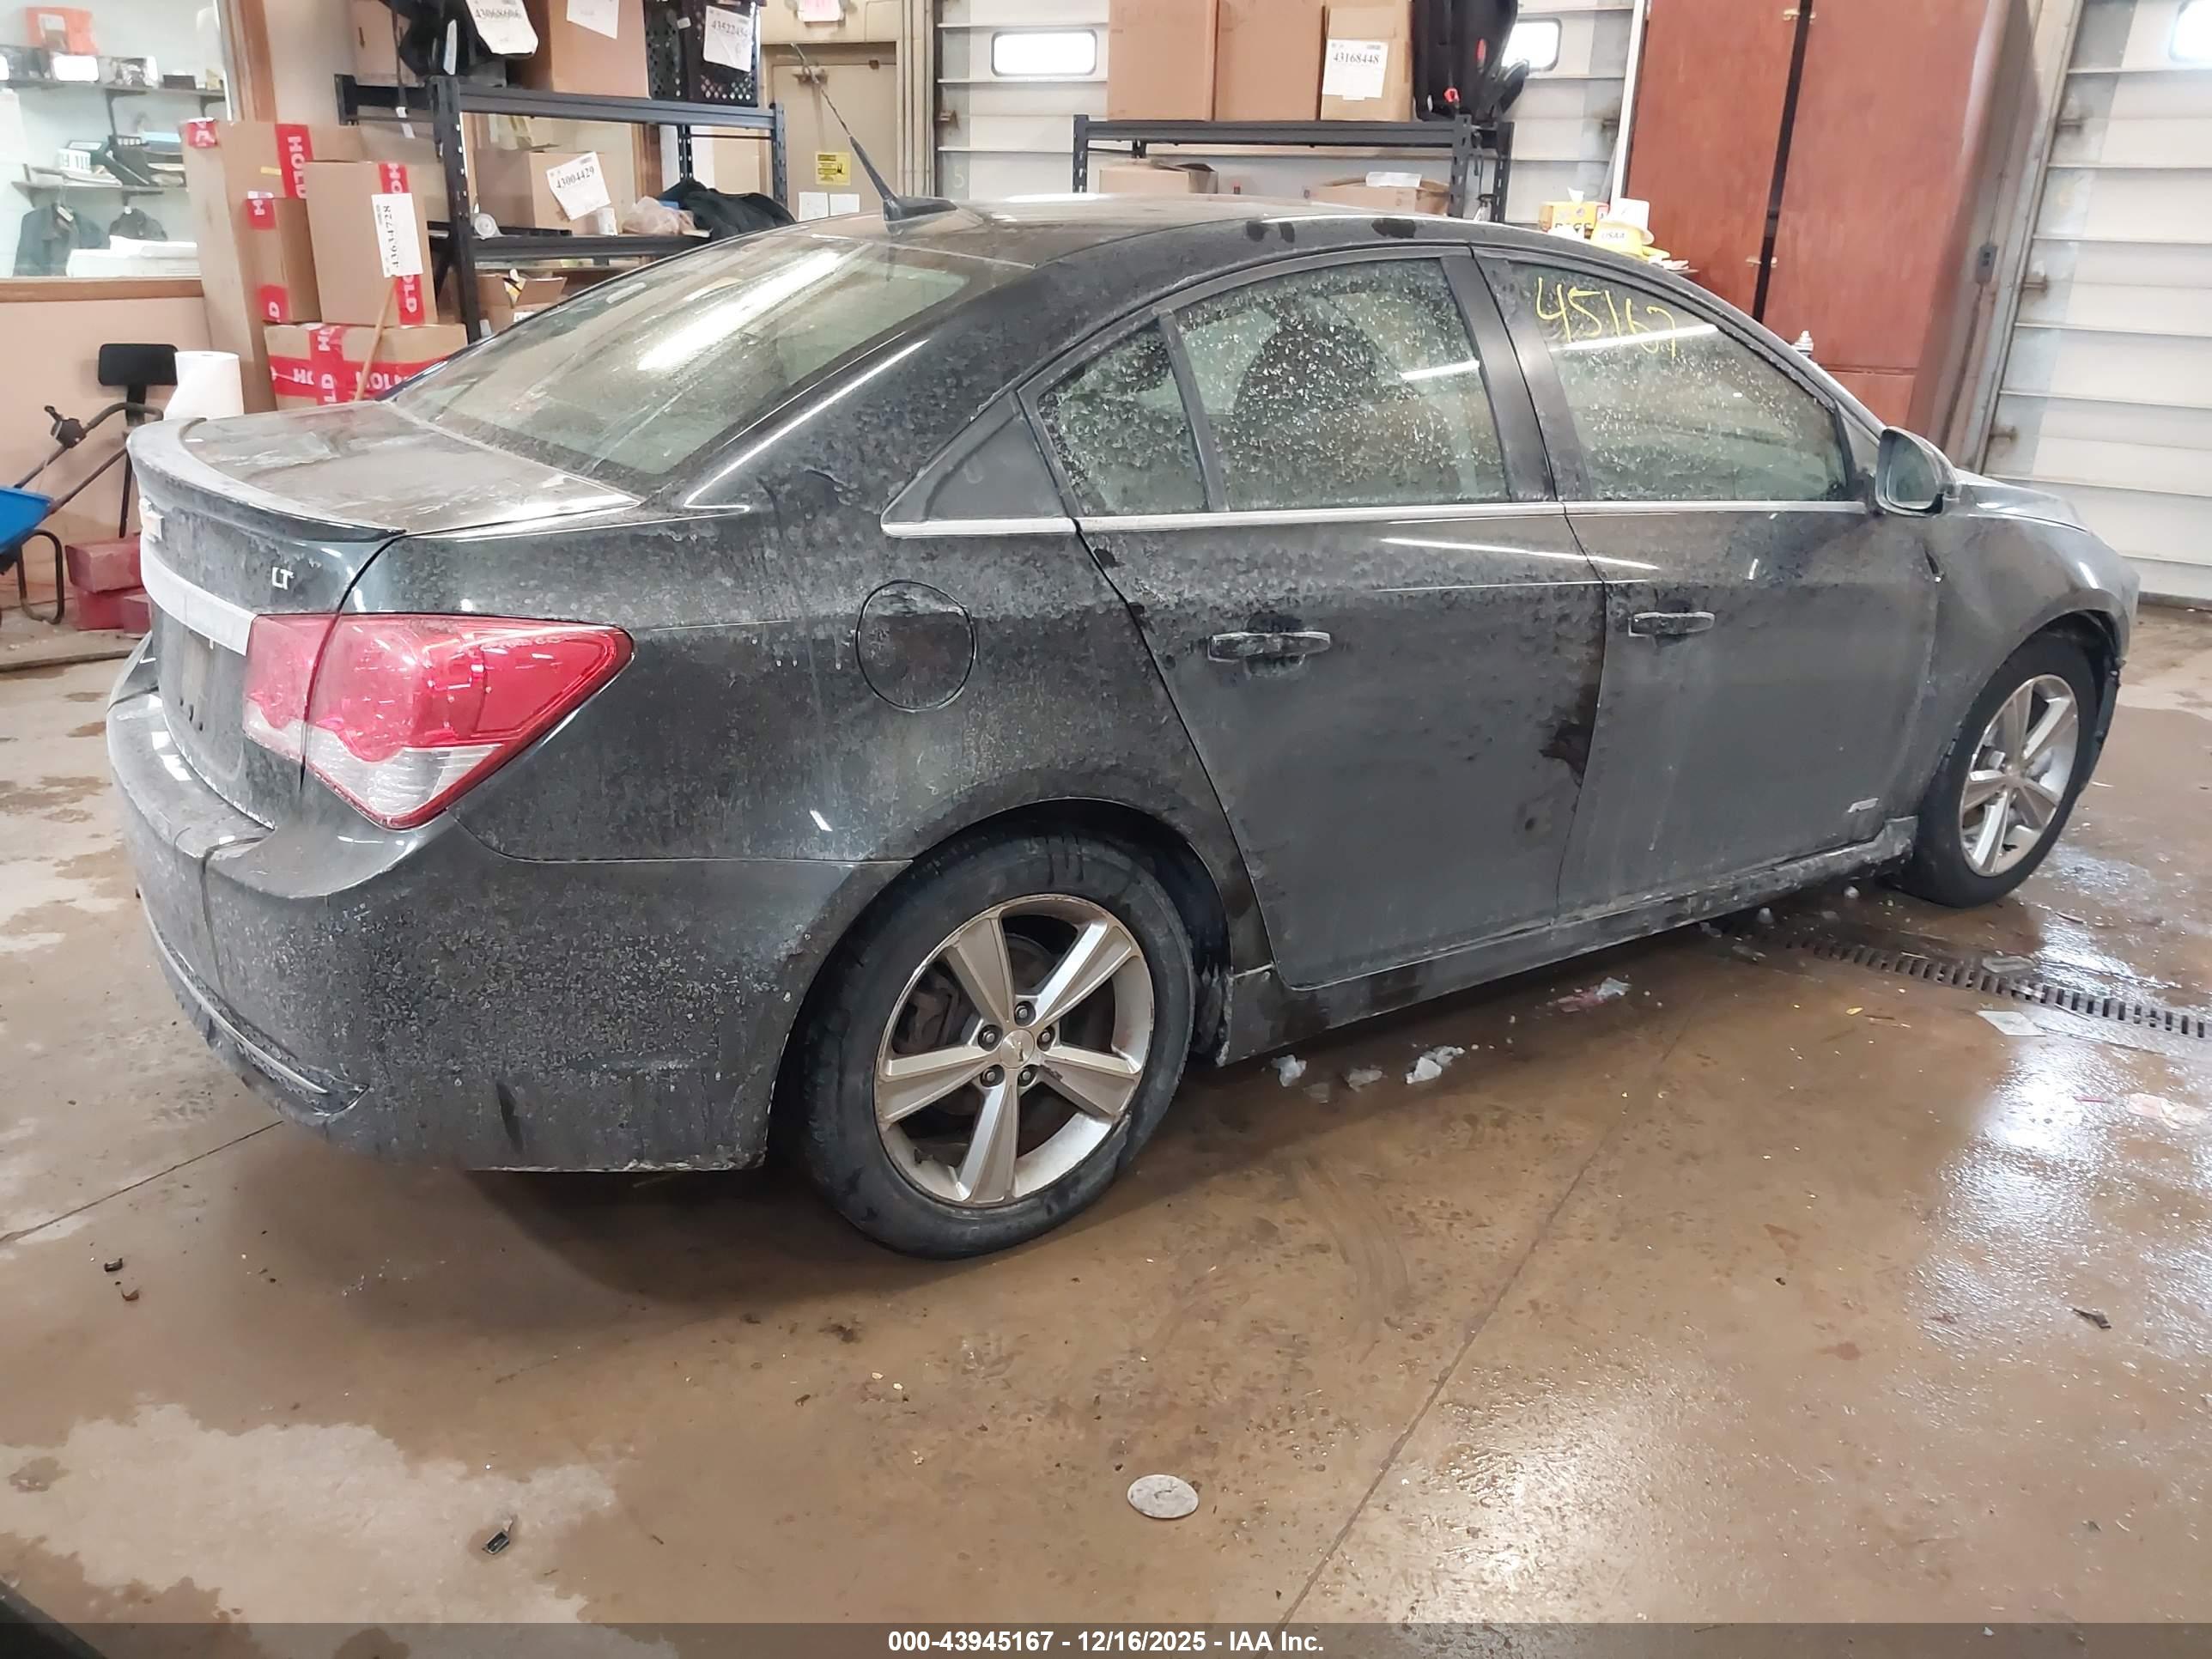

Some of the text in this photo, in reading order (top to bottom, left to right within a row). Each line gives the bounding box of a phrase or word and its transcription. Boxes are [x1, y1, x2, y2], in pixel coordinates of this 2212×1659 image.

[1333, 52, 1381, 64] 43168448
[556, 166, 594, 188] 43004429
[383, 205, 399, 268] 43634728
[272, 567, 294, 590] LT
